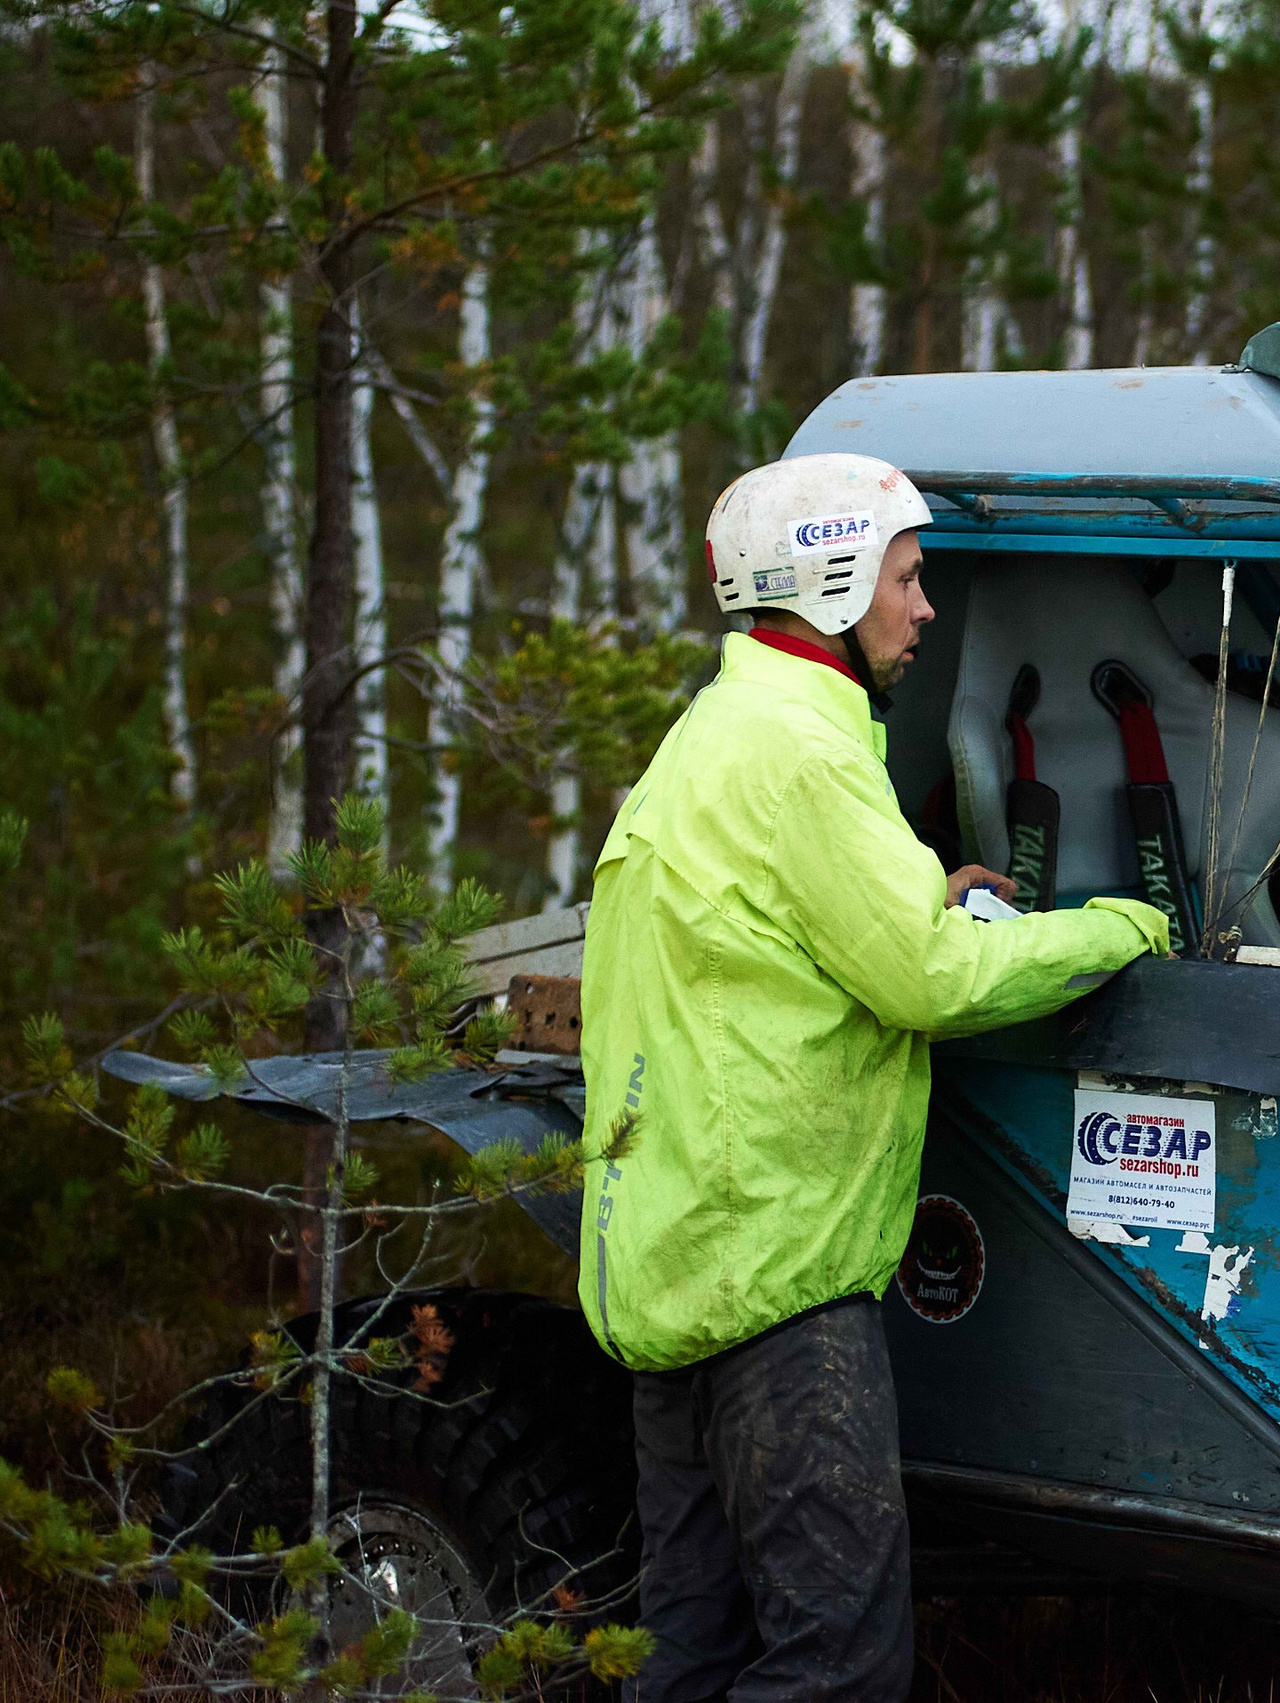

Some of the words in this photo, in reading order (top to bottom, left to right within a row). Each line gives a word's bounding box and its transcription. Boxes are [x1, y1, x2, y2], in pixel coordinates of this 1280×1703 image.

[810, 519, 870, 540] СЕЗАР
[822, 534, 866, 546] sezarshop.ru
[1126, 1114, 1185, 1128] автомагазин
[1101, 1122, 1212, 1161] СЕЗАР
[1119, 1158, 1200, 1179] sezarshop.ru
[1073, 1177, 1105, 1186] МАГАЗИН
[1106, 1180, 1147, 1190] АВТОМАСЕЛ
[1155, 1185, 1212, 1196] АВТОЗАПЧАСТЕЙ
[1108, 1195, 1175, 1208] 8(812)640-79-40
[1070, 1209, 1123, 1220] www.sezarshop.ru
[917, 1283, 959, 1303] АвтоКОТ
